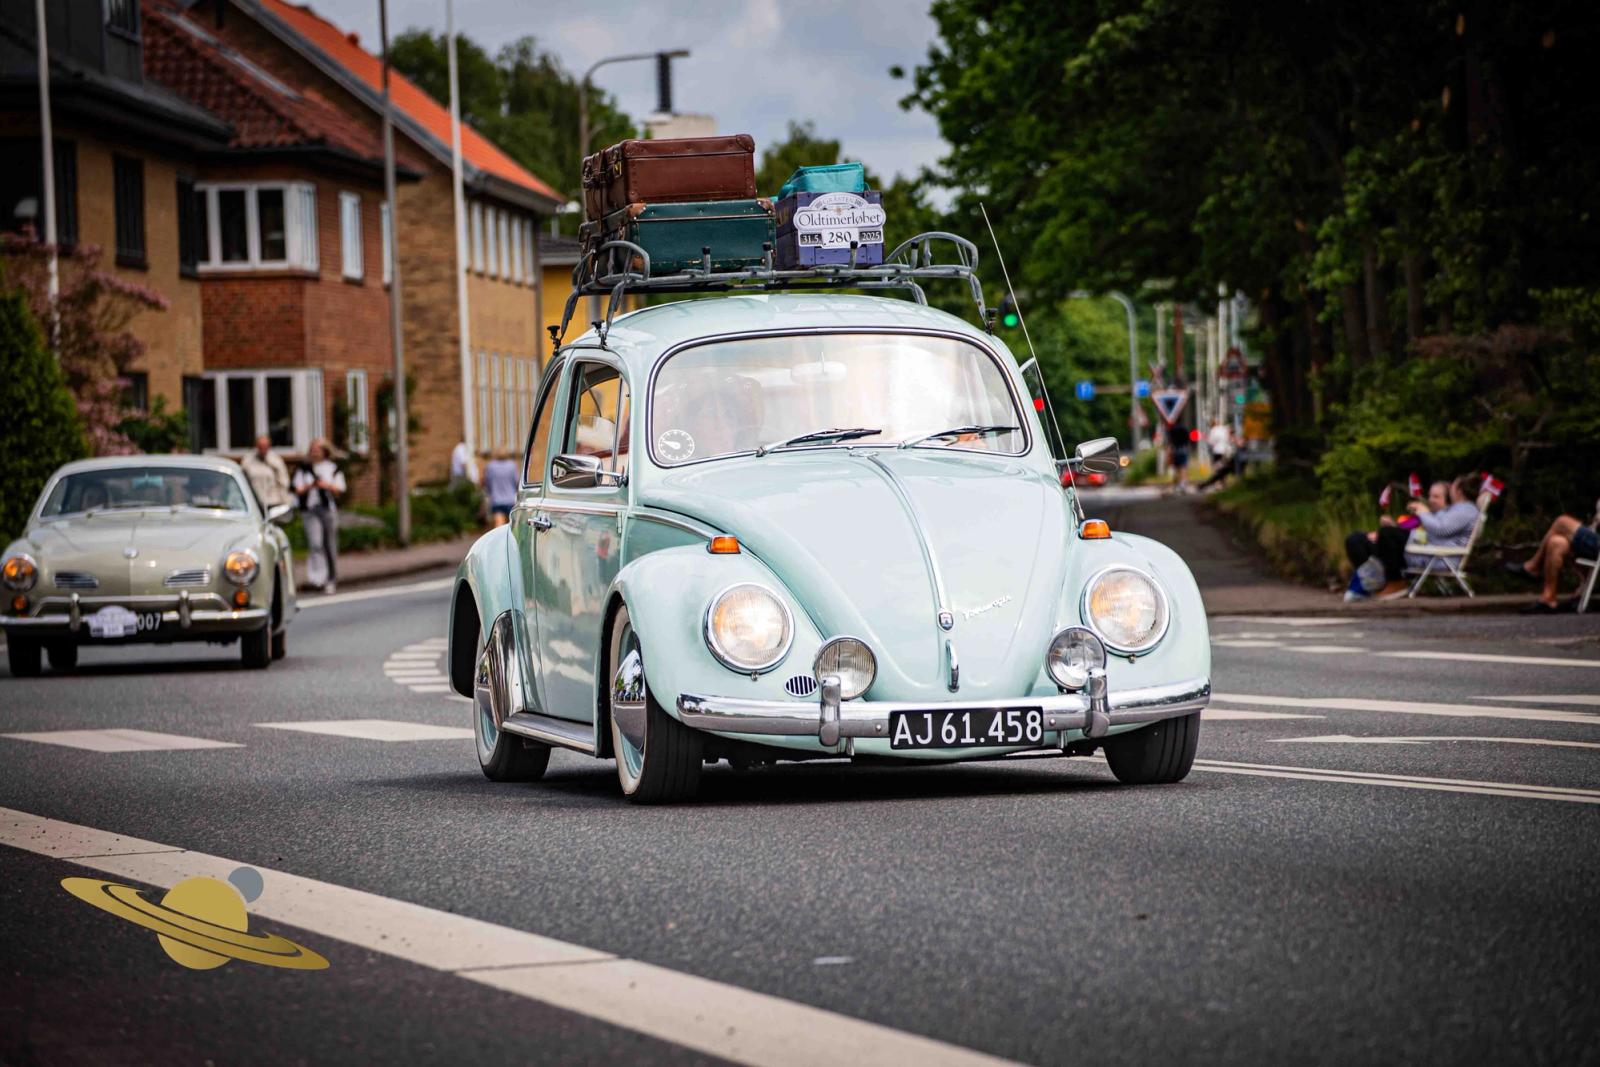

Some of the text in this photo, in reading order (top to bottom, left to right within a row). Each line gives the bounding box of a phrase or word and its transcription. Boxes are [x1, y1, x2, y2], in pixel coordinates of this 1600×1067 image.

[798, 211, 880, 226] Oldtimerløbet
[828, 231, 852, 243] 280
[861, 232, 880, 241] 2025
